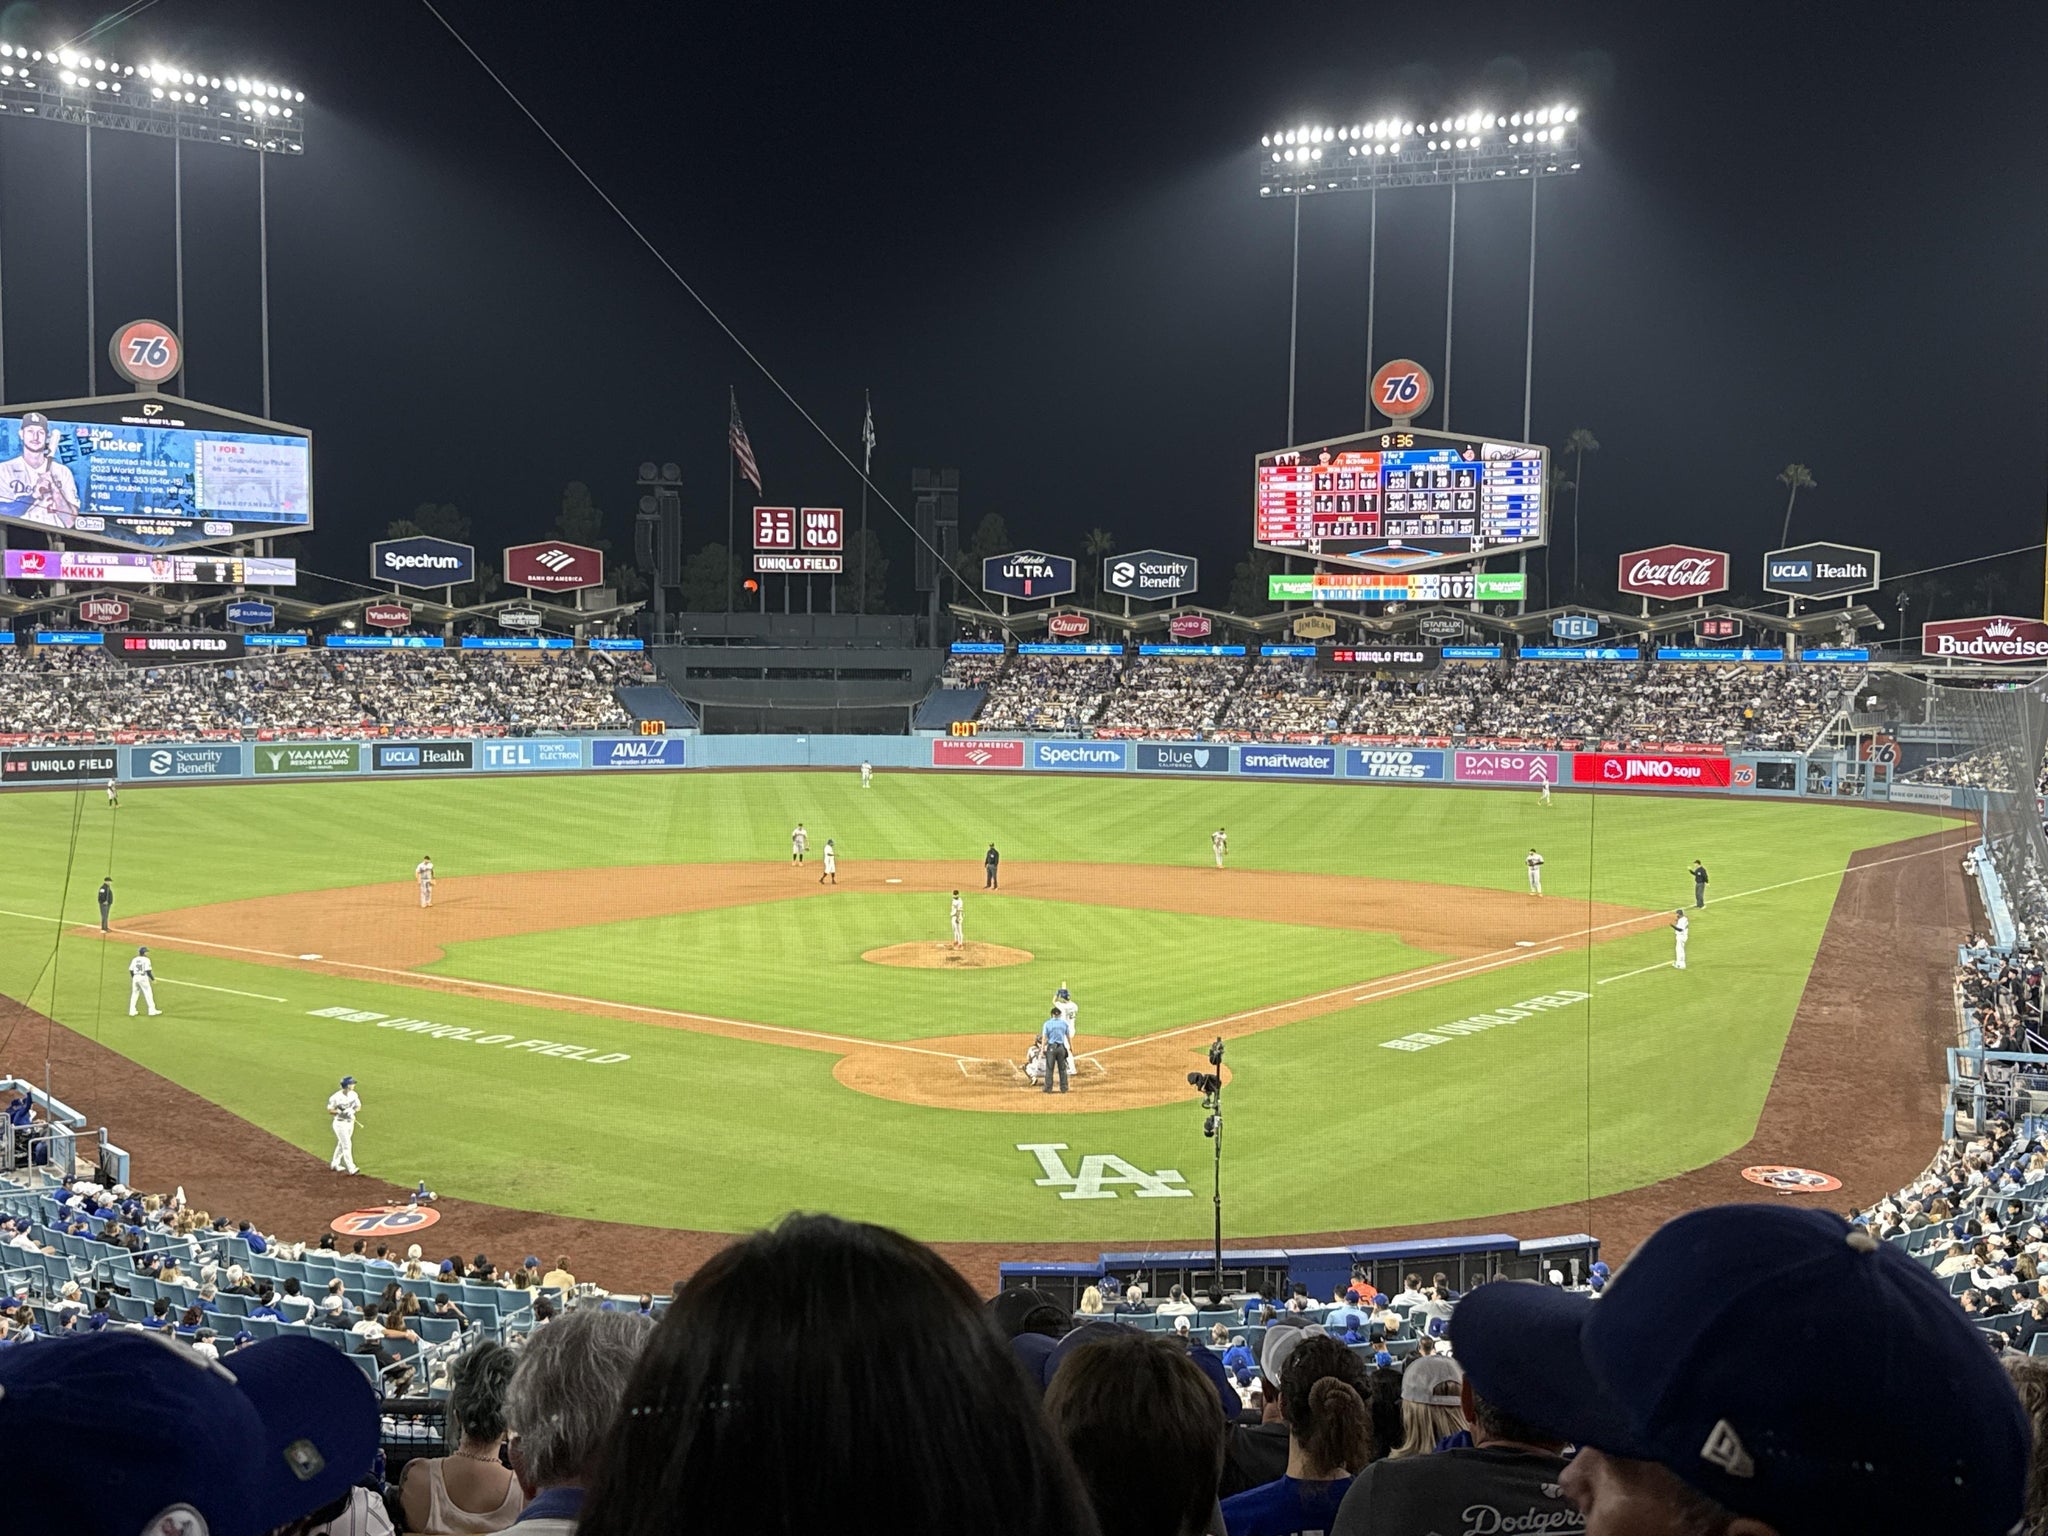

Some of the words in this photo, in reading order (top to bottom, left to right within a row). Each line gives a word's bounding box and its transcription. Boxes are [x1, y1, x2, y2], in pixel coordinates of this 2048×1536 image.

[128, 336, 170, 368] 76
[1382, 372, 1420, 403] 76
[92, 428, 113, 439] Kyle
[90, 437, 143, 452] Tucker
[1381, 434, 1414, 448] 8:36
[219, 446, 237, 454] FOR
[90, 465, 111, 473] 2023
[112, 466, 135, 474] World
[1388, 479, 1405, 488] .252
[1416, 479, 1422, 488] 4
[1315, 501, 1333, 512] 11.2
[1341, 501, 1350, 512] 11
[1365, 501, 1370, 511] 1
[1387, 501, 1405, 511] .345
[1410, 500, 1428, 511] .395
[1432, 500, 1450, 510] .740
[1457, 499, 1472, 509] 147
[806, 513, 835, 528] UNI
[136, 525, 175, 536] $30,500
[806, 529, 838, 546] QLO
[77, 554, 119, 565] K-METER
[384, 552, 458, 570] Spectrum
[759, 558, 801, 571] UNIQLO
[803, 558, 838, 569] FIELD
[1003, 565, 1054, 578] ULTRA
[1139, 562, 1188, 577] Security
[1628, 558, 1716, 586] Coca-Cola
[1772, 564, 1808, 578] UCLA
[1815, 563, 1868, 578] Health
[1139, 575, 1181, 588] Benefit
[1464, 582, 1473, 598] 2
[89, 603, 122, 618] JINRO
[369, 611, 409, 621] Yakult
[1050, 619, 1088, 632] Churu
[1297, 621, 1312, 633] JIM
[1311, 619, 1331, 633] BEAM
[1558, 619, 1593, 635] TEL
[149, 639, 191, 651] UNIQLO
[193, 639, 227, 651] FIELD
[1937, 635, 2048, 655] Budweise
[1355, 651, 1391, 663] UNIQLO
[1393, 652, 1424, 662] FIELD
[640, 720, 666, 736] 0:07
[951, 721, 977, 737] 0:07
[611, 742, 648, 757] ANA
[978, 741, 1014, 749] AMERICA
[176, 750, 223, 764] Security
[386, 752, 415, 762] UCLA
[422, 750, 465, 762] Health
[486, 745, 530, 765] TEL
[540, 752, 579, 760] ELECTRON
[1040, 746, 1115, 764] Spectrum
[1158, 749, 1193, 763] blue
[1245, 753, 1330, 769] smartwater
[1360, 751, 1414, 764] TOYO
[31, 759, 76, 772] UNIQLO
[78, 758, 114, 770] FIELD
[176, 763, 217, 774] Benefit
[1465, 756, 1525, 770] DAISO
[1624, 759, 1673, 781] JINRO
[1368, 764, 1426, 778] TIRES
[1734, 770, 1753, 782] 76
[1429, 1007, 1533, 1036] UNIQLO
[1512, 990, 1594, 1012] FIELD
[376, 1017, 515, 1045] UNIQLO
[505, 1039, 632, 1064] FIELD
[1016, 1143, 1194, 1200] LA
[345, 1207, 428, 1233] 76
[1461, 1504, 1587, 1536] Dodgers
